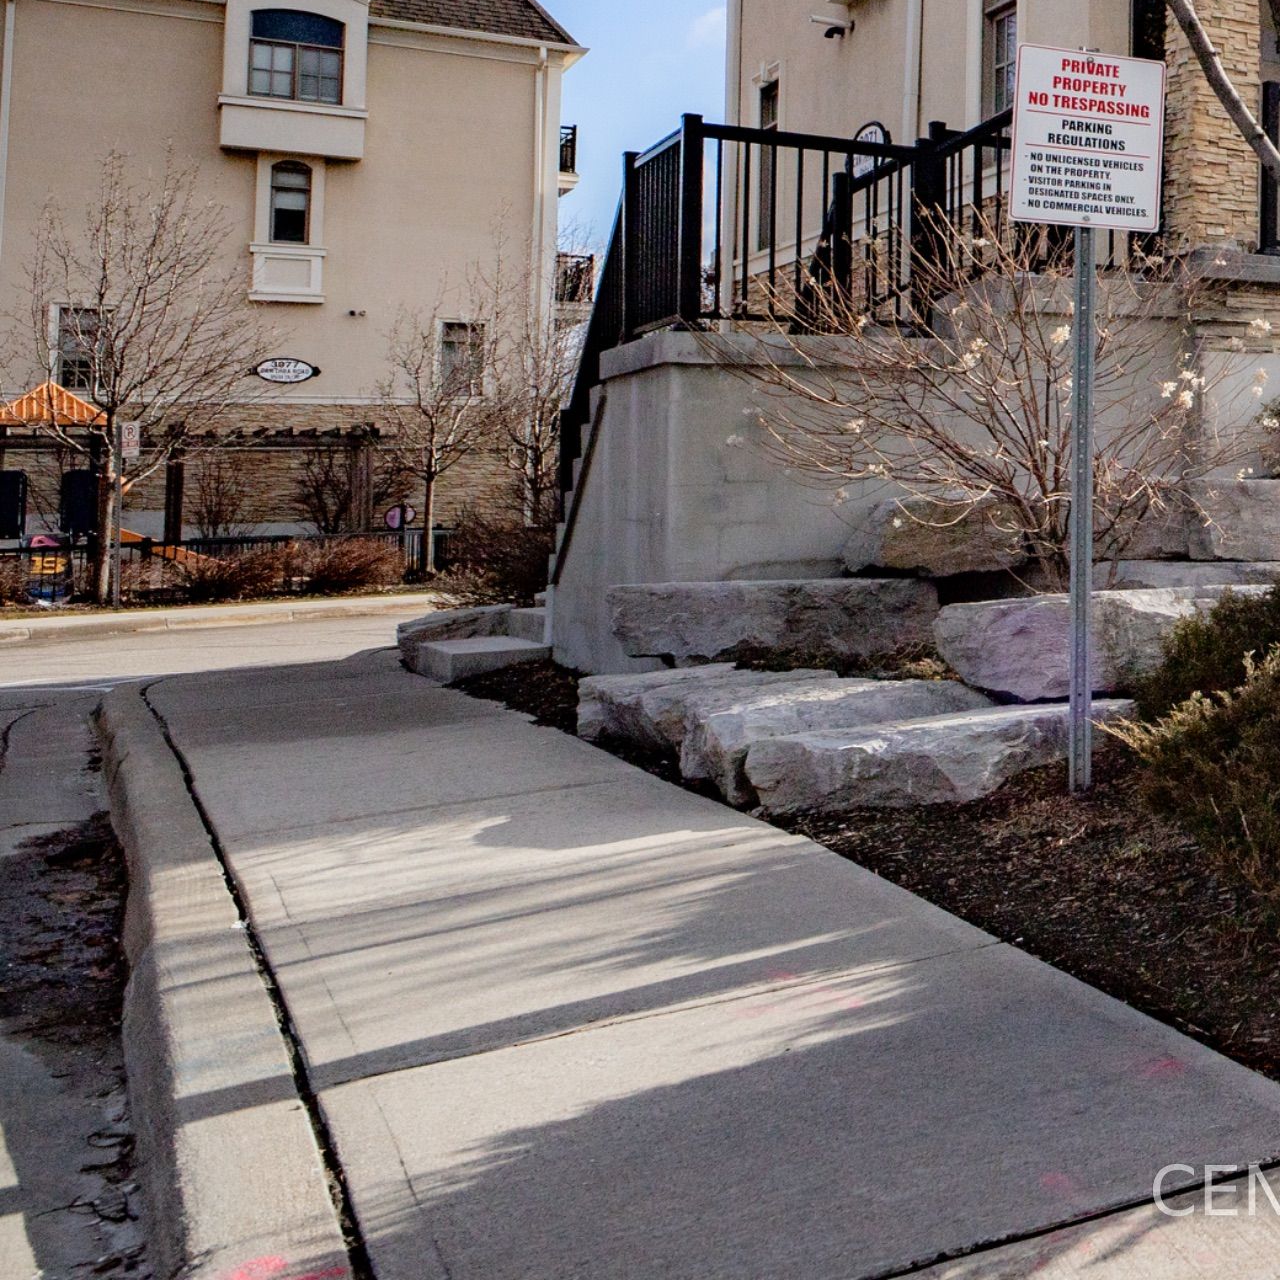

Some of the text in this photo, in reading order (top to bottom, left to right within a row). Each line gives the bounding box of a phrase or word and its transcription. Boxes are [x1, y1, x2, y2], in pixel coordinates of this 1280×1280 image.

[1061, 58, 1120, 79] PRIVATE
[1052, 75, 1127, 98] PROPERTY
[1028, 91, 1150, 119] NO TRESPASSING
[1061, 119, 1113, 135] PARKING
[1047, 132, 1126, 152] REGULATIONS
[1030, 151, 1145, 172] NO UNLICENSED VEHICLES
[1030, 163, 1112, 181] ON THE PROPERTY.
[1028, 175, 1112, 192] VISITOR PARKING IN
[1028, 186, 1136, 205] DESIGNATED SPACES ONLY.
[1028, 199, 1149, 218] NO COMMERCIAL VEHICLES.
